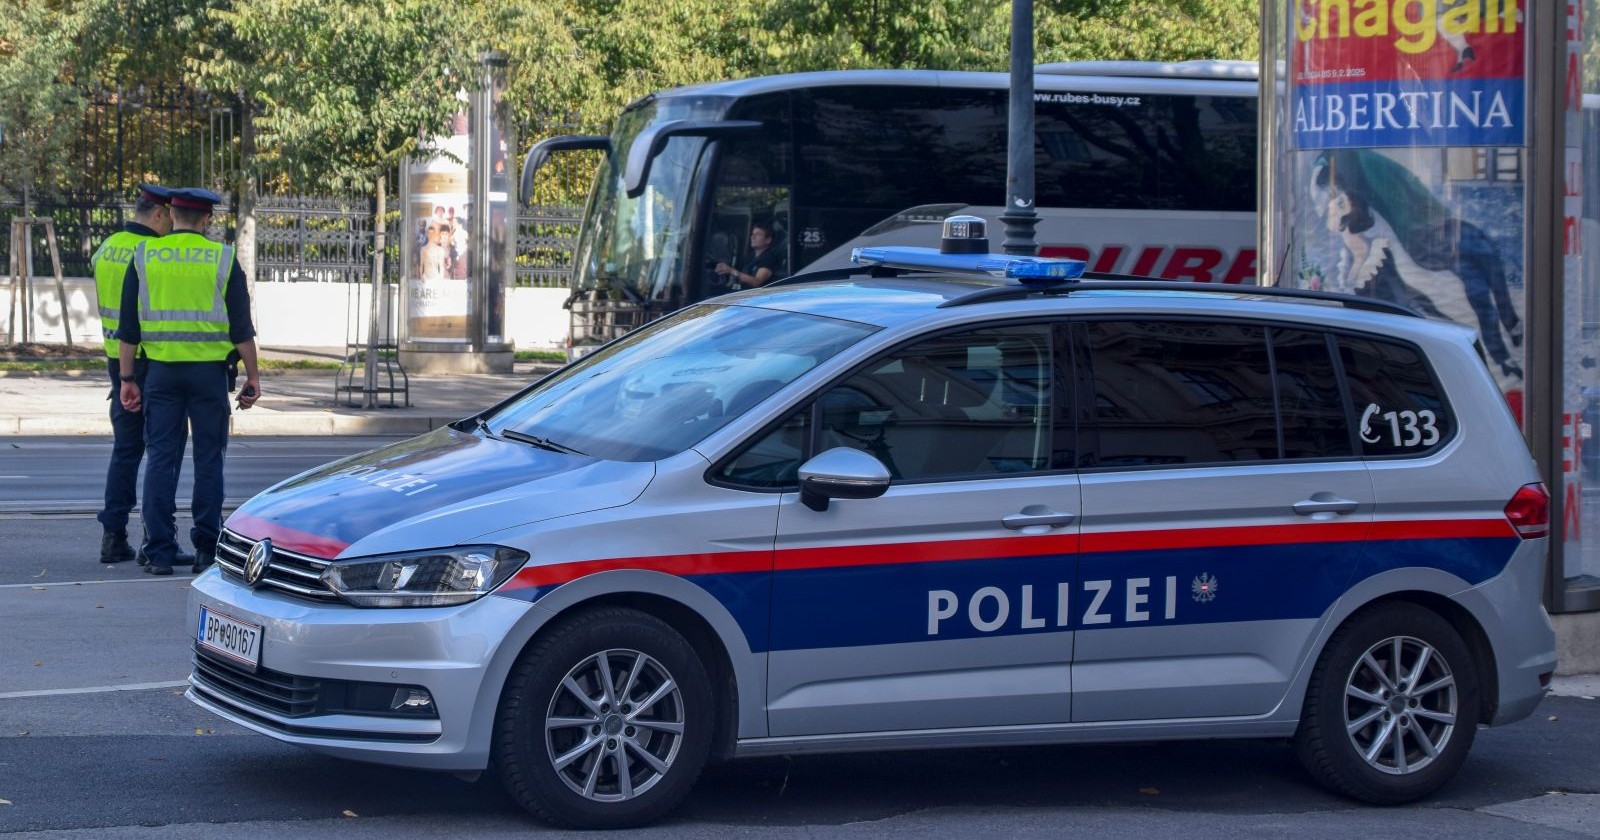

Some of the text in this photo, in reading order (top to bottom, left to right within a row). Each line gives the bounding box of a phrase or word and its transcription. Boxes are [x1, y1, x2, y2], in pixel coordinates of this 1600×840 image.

[1294, 89, 1513, 132] ALBERTINA
[146, 247, 219, 264] POLIZEI
[803, 231, 820, 243] 25
[1383, 409, 1440, 447] 133
[328, 464, 439, 497] POLIZEI
[927, 576, 1176, 635] POLIZEI
[207, 616, 220, 643] BP
[225, 623, 256, 656] 90167
